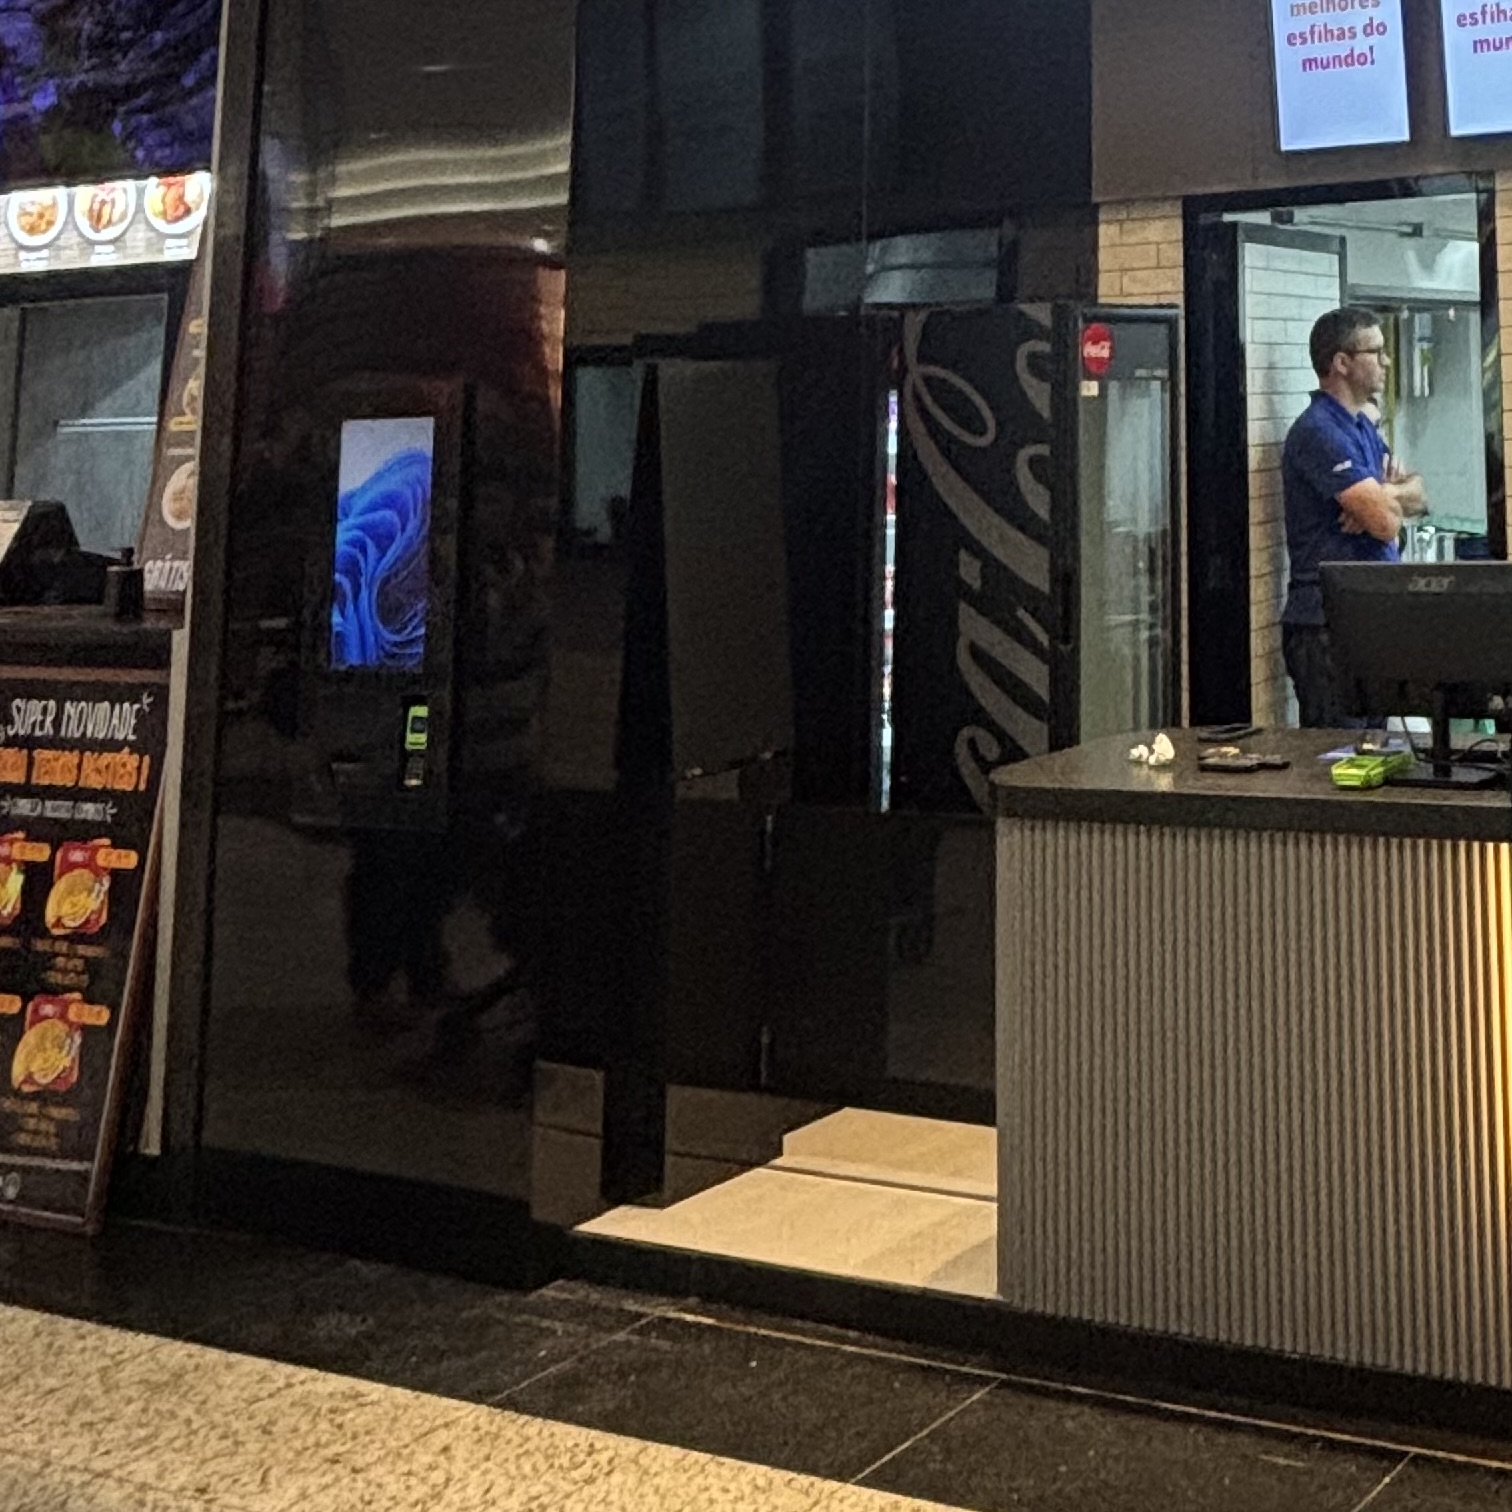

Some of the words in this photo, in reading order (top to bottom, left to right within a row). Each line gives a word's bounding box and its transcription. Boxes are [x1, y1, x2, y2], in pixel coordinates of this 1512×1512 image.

[1286, 21, 1357, 46] esfihas
[1362, 17, 1387, 38] do
[1302, 46, 1375, 72] mundo!
[7, 699, 56, 736] SUPER
[61, 701, 141, 741] NOVIDADE
